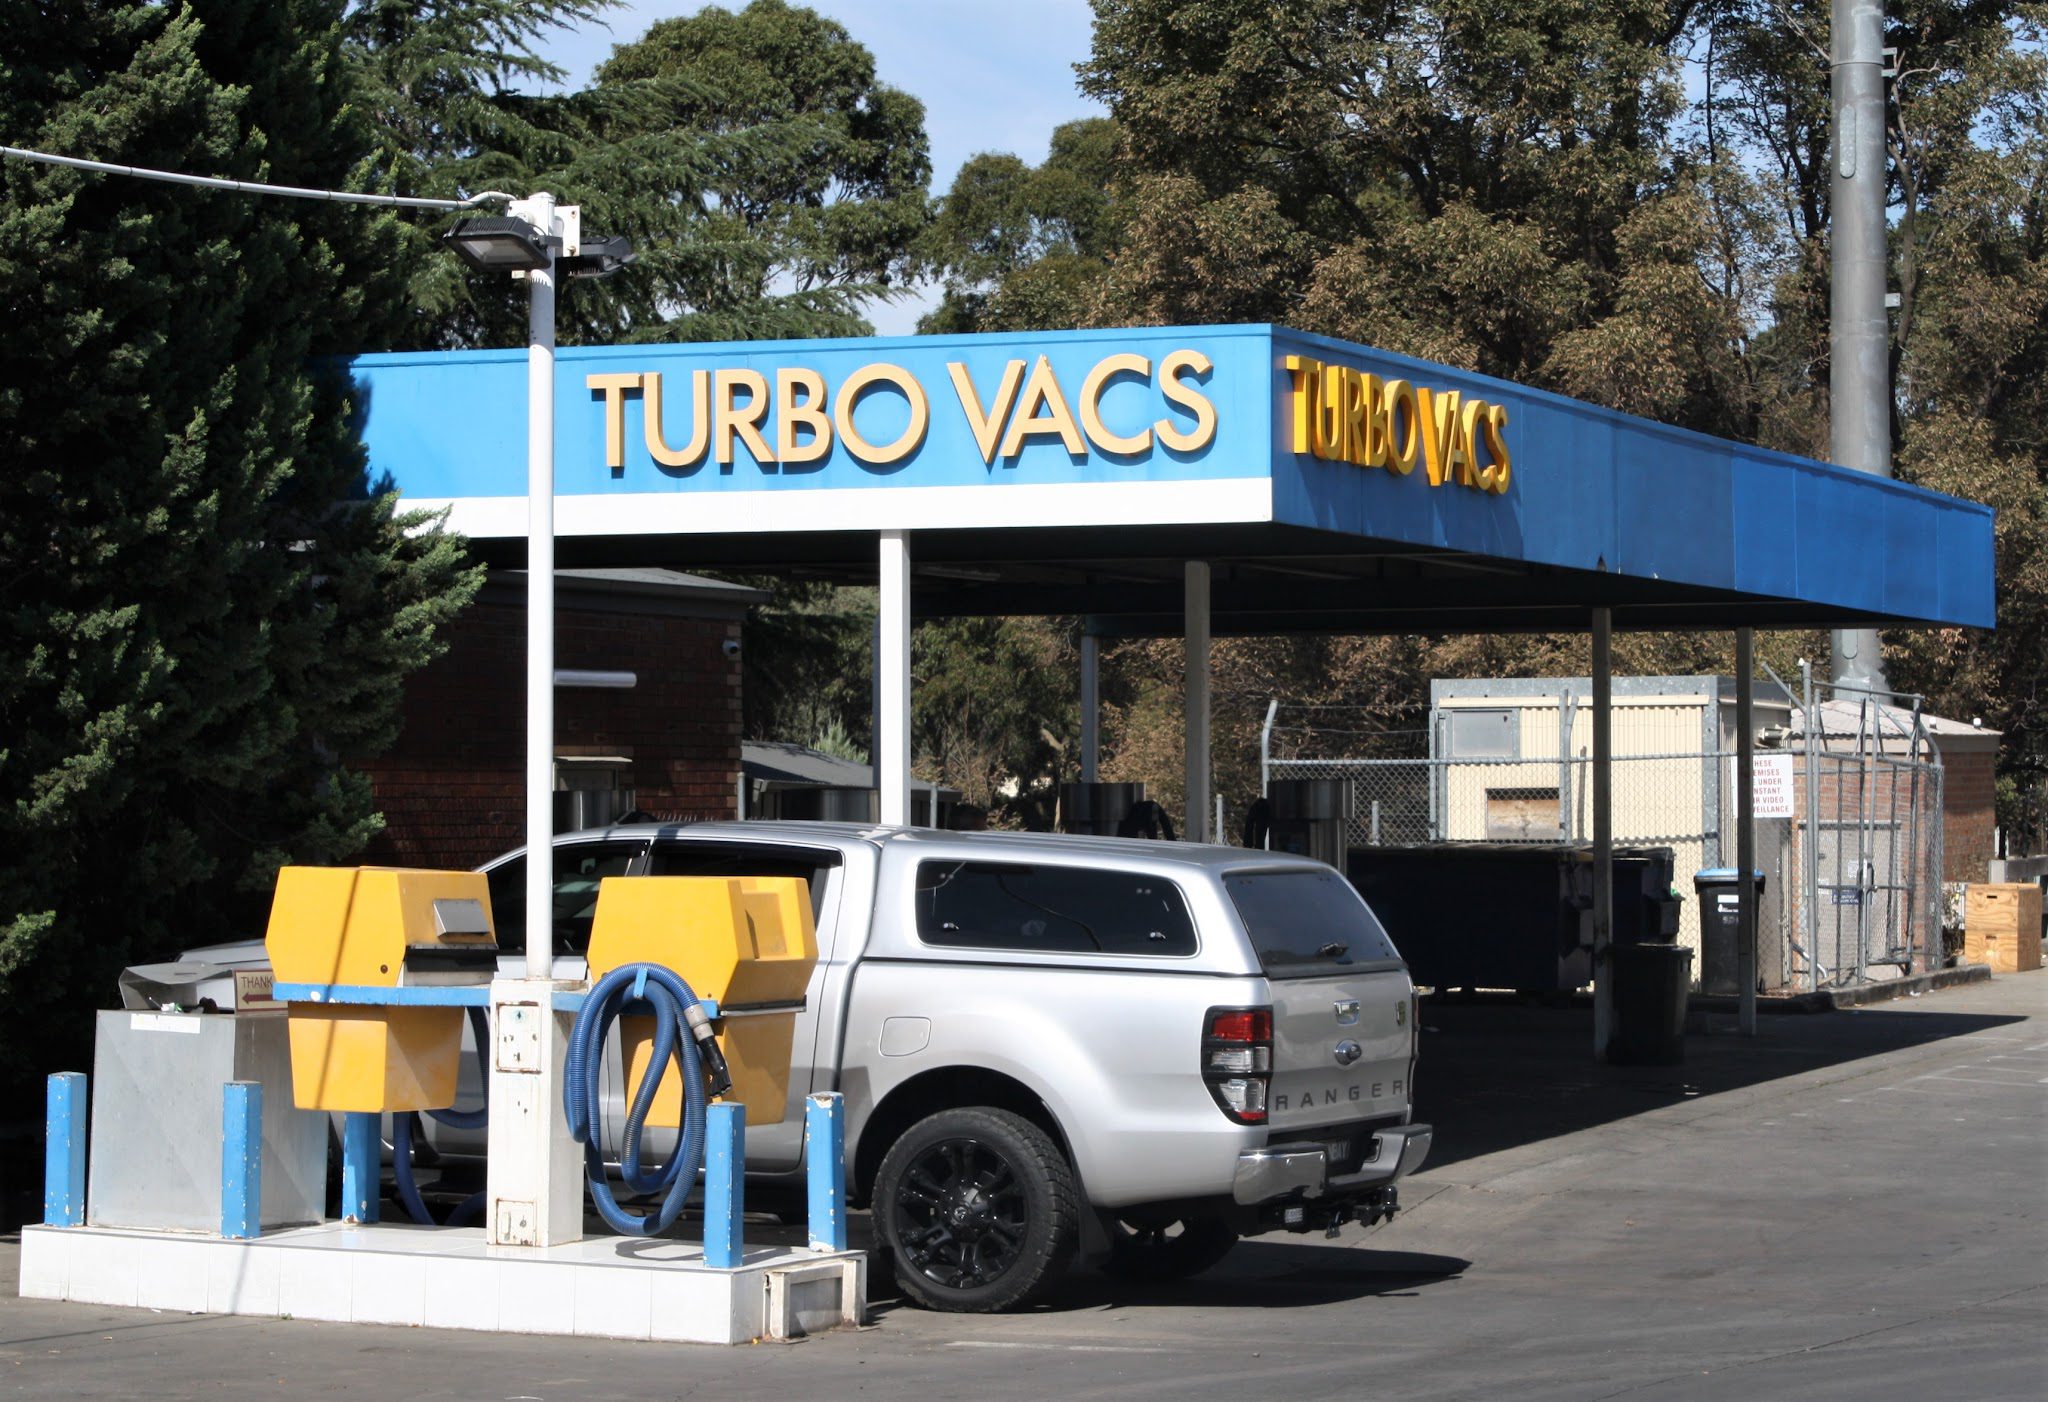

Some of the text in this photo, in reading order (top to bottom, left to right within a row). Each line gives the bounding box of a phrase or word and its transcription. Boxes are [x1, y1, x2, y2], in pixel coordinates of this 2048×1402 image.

[586, 349, 1217, 468] TURBO VACS
[1286, 355, 1512, 495] TURBO VACS
[1754, 759, 1773, 767] HESE
[1753, 787, 1781, 795] NSTANT
[1753, 805, 1790, 813] VEILLANCE
[1275, 1080, 1403, 1111] RANGER
